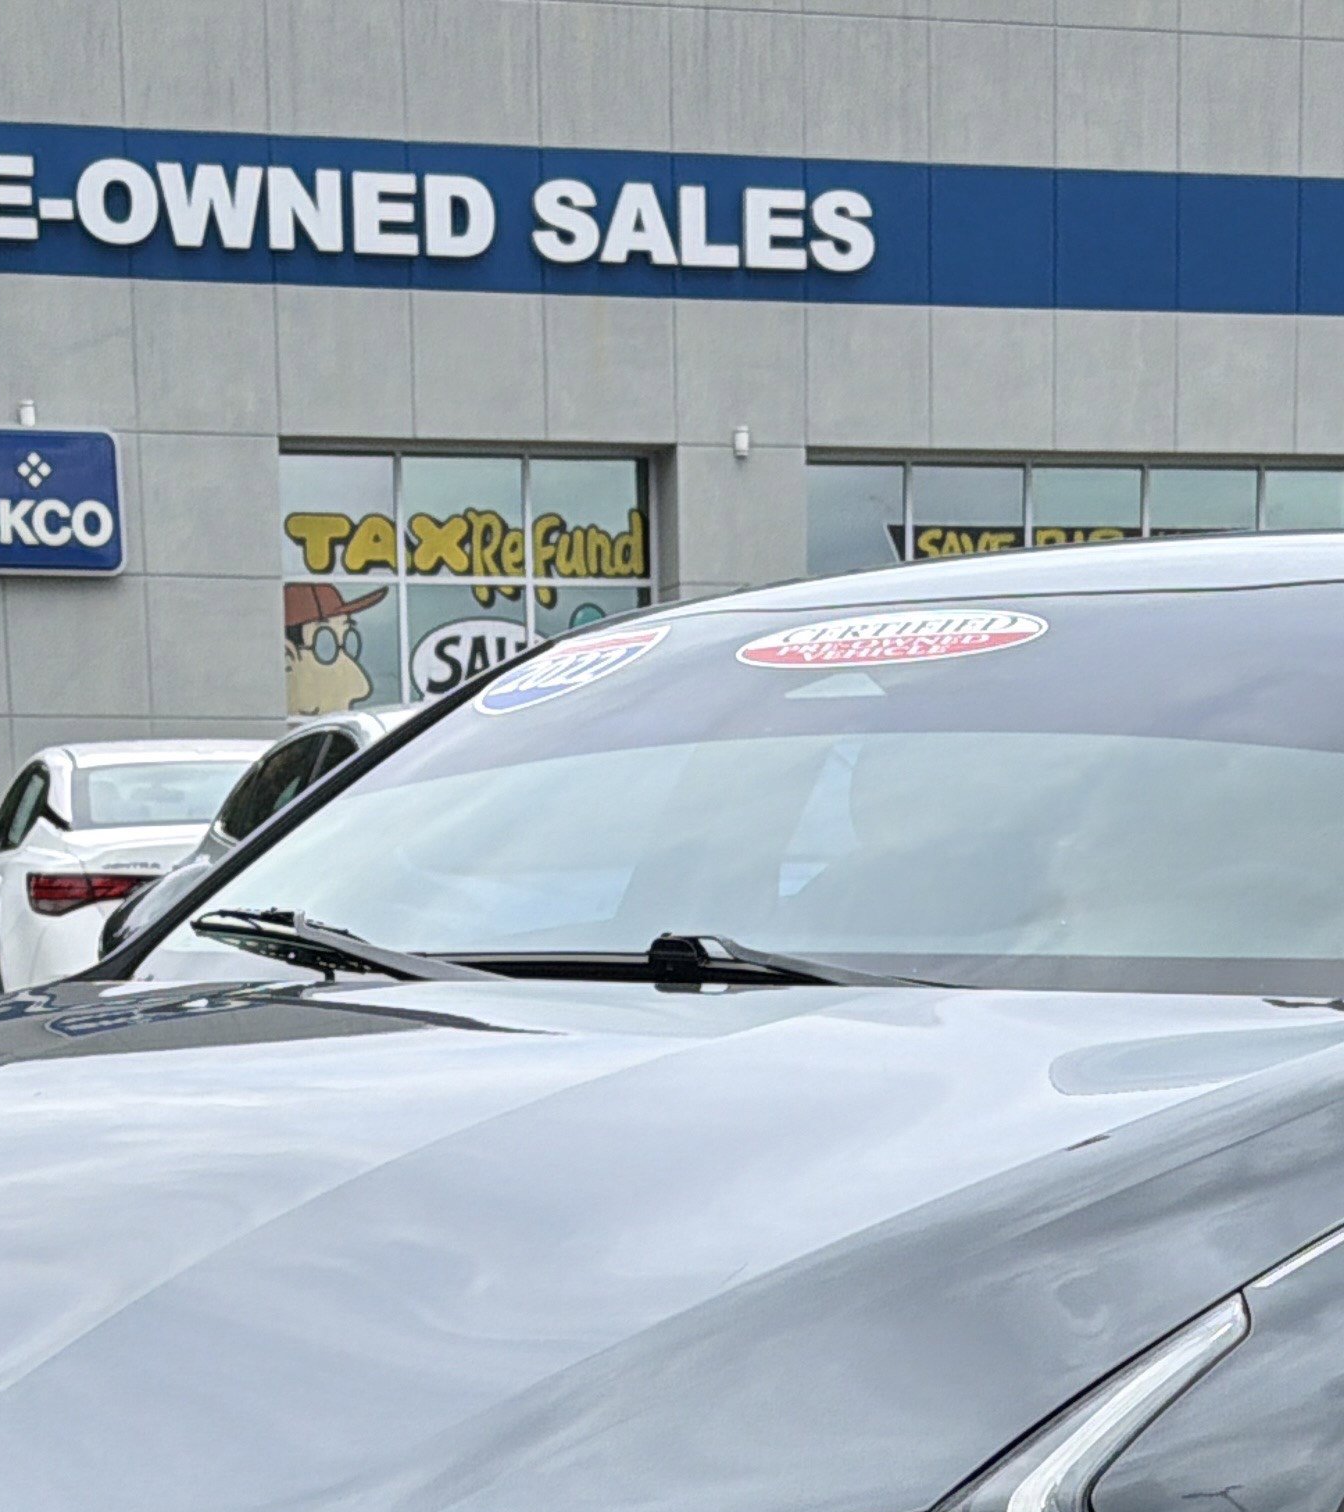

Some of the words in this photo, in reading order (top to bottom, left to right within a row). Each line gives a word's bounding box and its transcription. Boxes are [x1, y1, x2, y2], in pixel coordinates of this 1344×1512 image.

[531, 178, 876, 273] SALES
[783, 616, 1019, 643] CERTIFIED
[426, 635, 527, 694] SA
